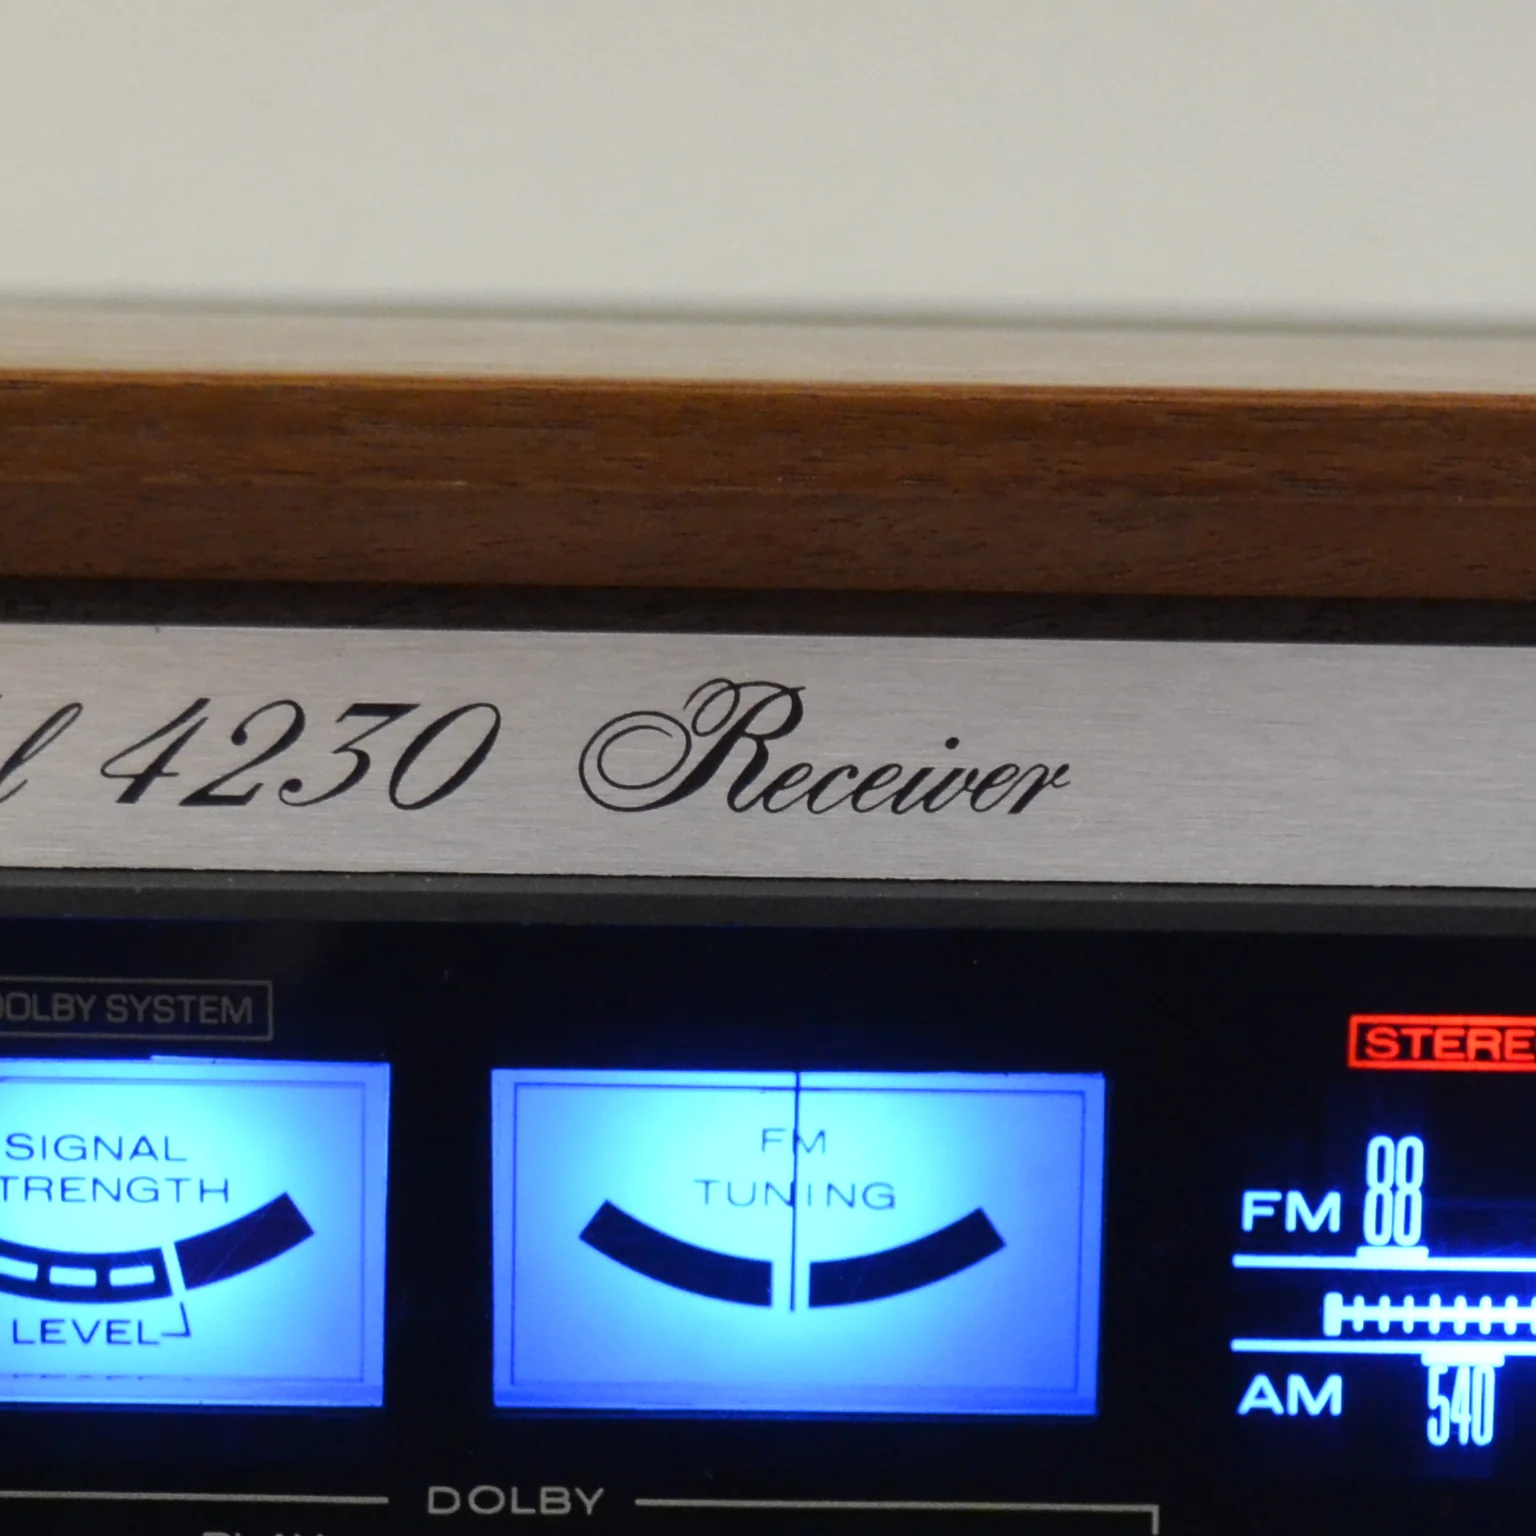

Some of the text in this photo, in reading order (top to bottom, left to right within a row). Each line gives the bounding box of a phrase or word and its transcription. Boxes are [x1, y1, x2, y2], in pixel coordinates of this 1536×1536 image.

[100, 697, 501, 812] 4230
[579, 677, 1070, 814] Receiver
[105, 994, 254, 1026] SYSTEM
[4, 1133, 188, 1163] SIGNAL
[761, 1128, 827, 1154] FM
[694, 1178, 896, 1210] TUNING
[1240, 1190, 1343, 1232] FM
[1363, 1135, 1425, 1247] 88
[12, 1318, 161, 1345] LEVEL
[1237, 1375, 1343, 1416] AM
[1426, 1363, 1495, 1446] 540
[427, 1485, 605, 1516] DOLBY
